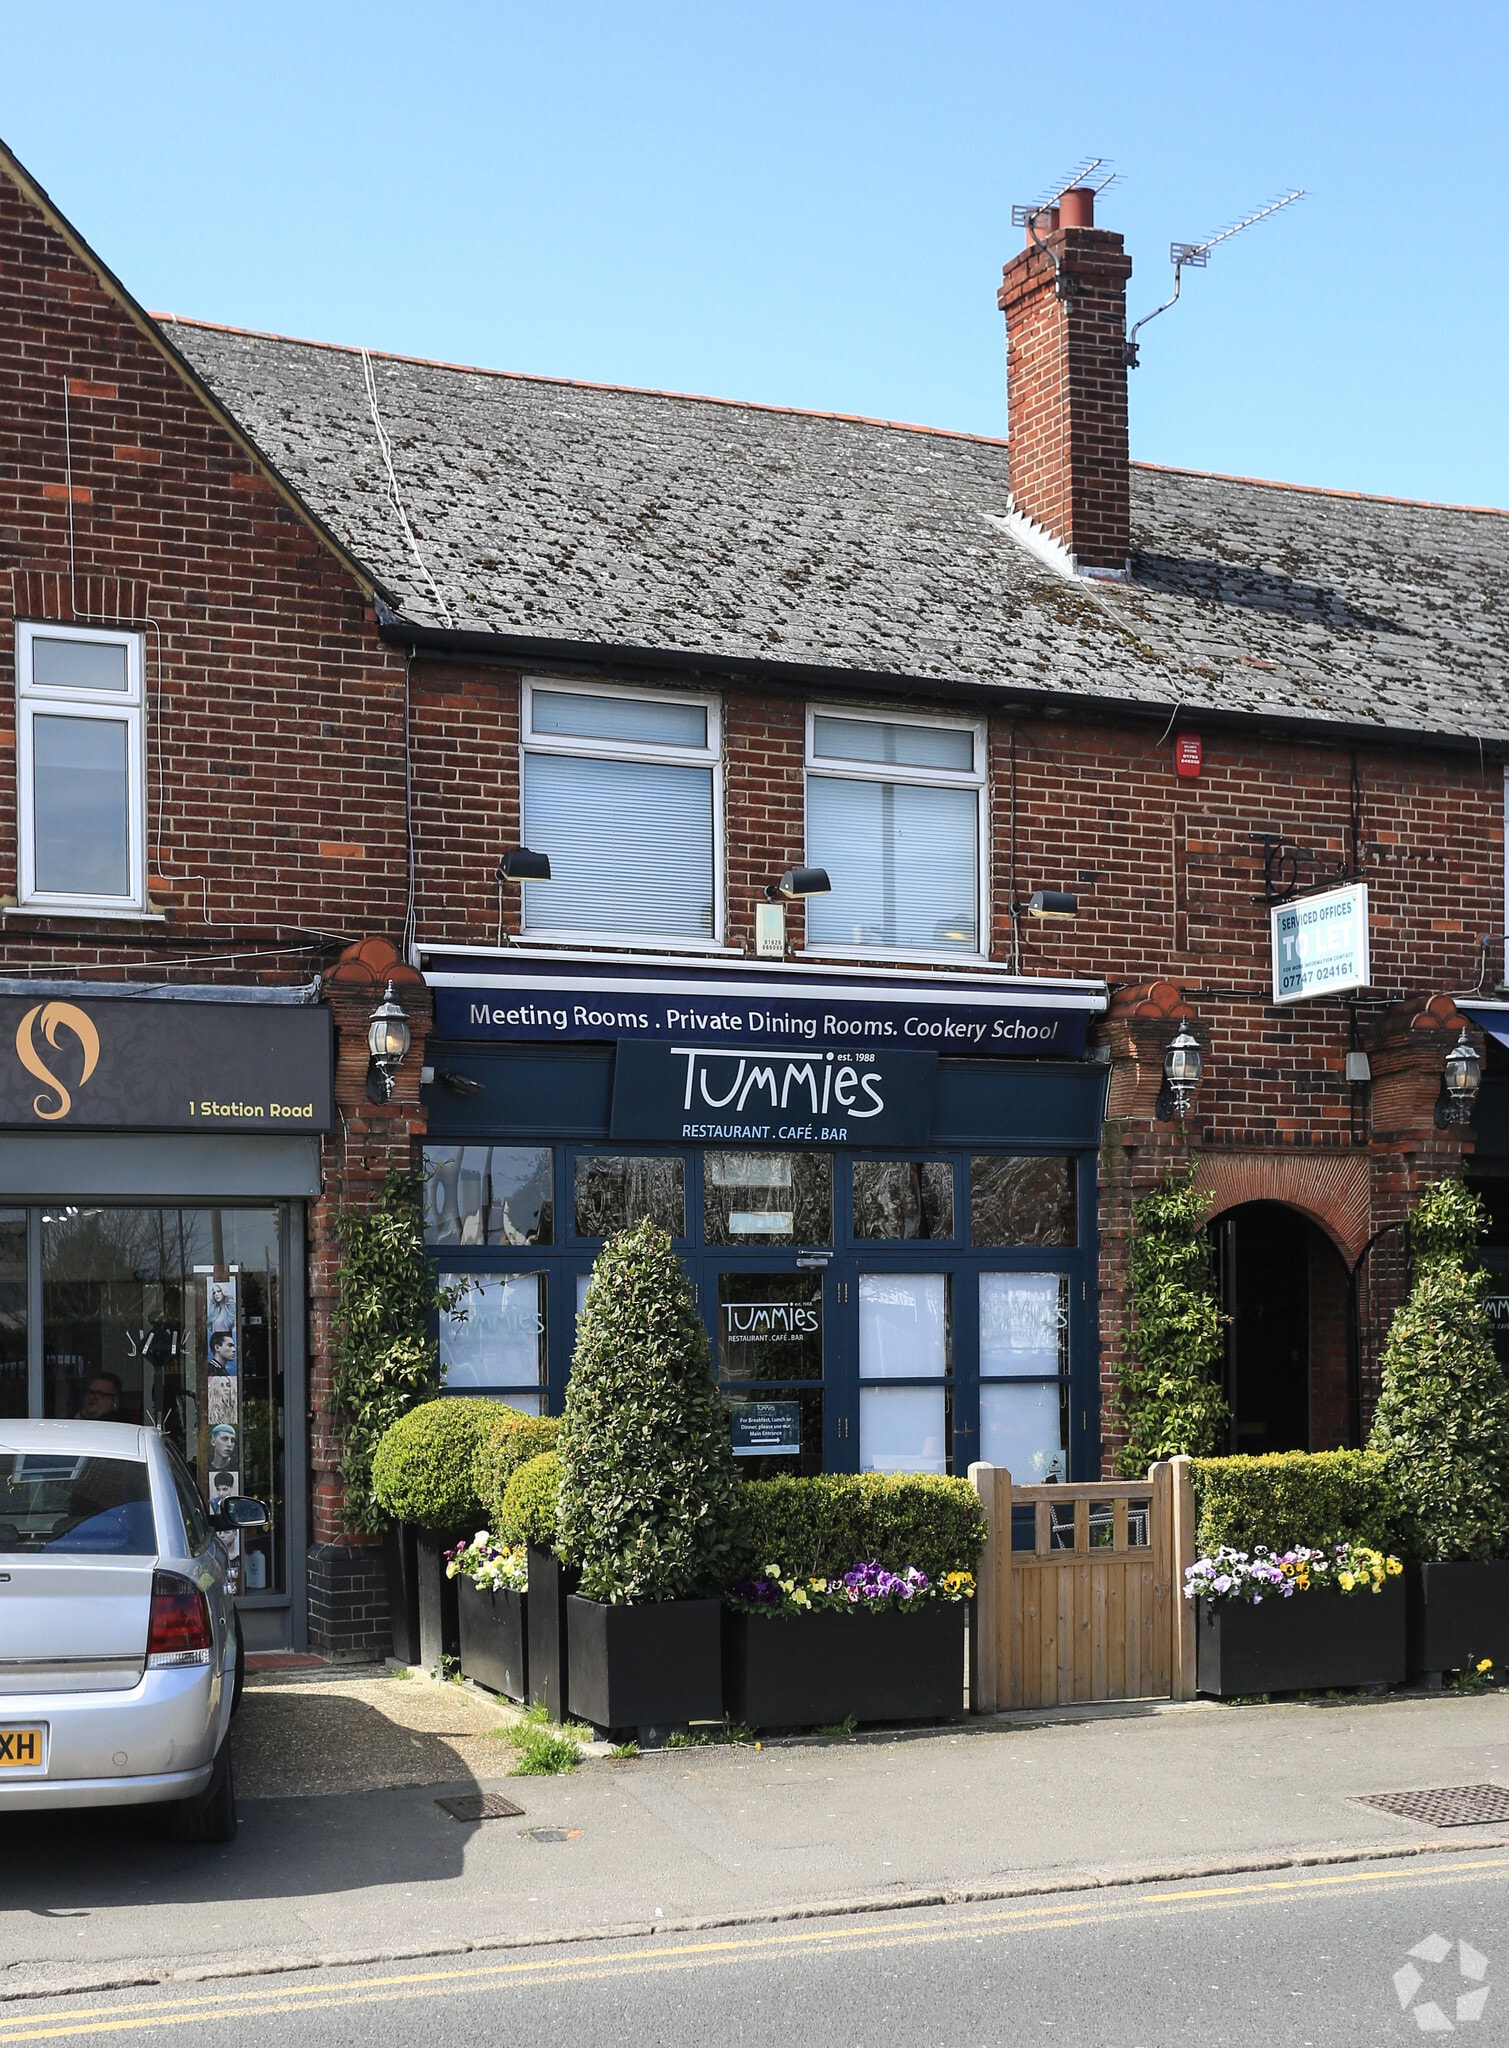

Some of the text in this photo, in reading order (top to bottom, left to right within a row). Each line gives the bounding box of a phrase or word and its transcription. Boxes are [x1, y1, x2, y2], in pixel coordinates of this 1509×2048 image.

[1282, 902, 1352, 931] SERVICED OFFICES
[1283, 920, 1353, 961] TO LET
[1283, 962, 1353, 988] 07747 024161
[470, 1004, 568, 1030] Meeting
[666, 1009, 743, 1031] Private
[749, 1011, 817, 1039] Dining
[904, 1017, 985, 1043] Cookery
[991, 1020, 1058, 1040] School
[837, 1053, 875, 1062] est. 1988
[189, 1101, 313, 1118] 1 Station Road
[682, 1124, 770, 1139] RESTAURANT
[820, 1127, 848, 1141] BAR
